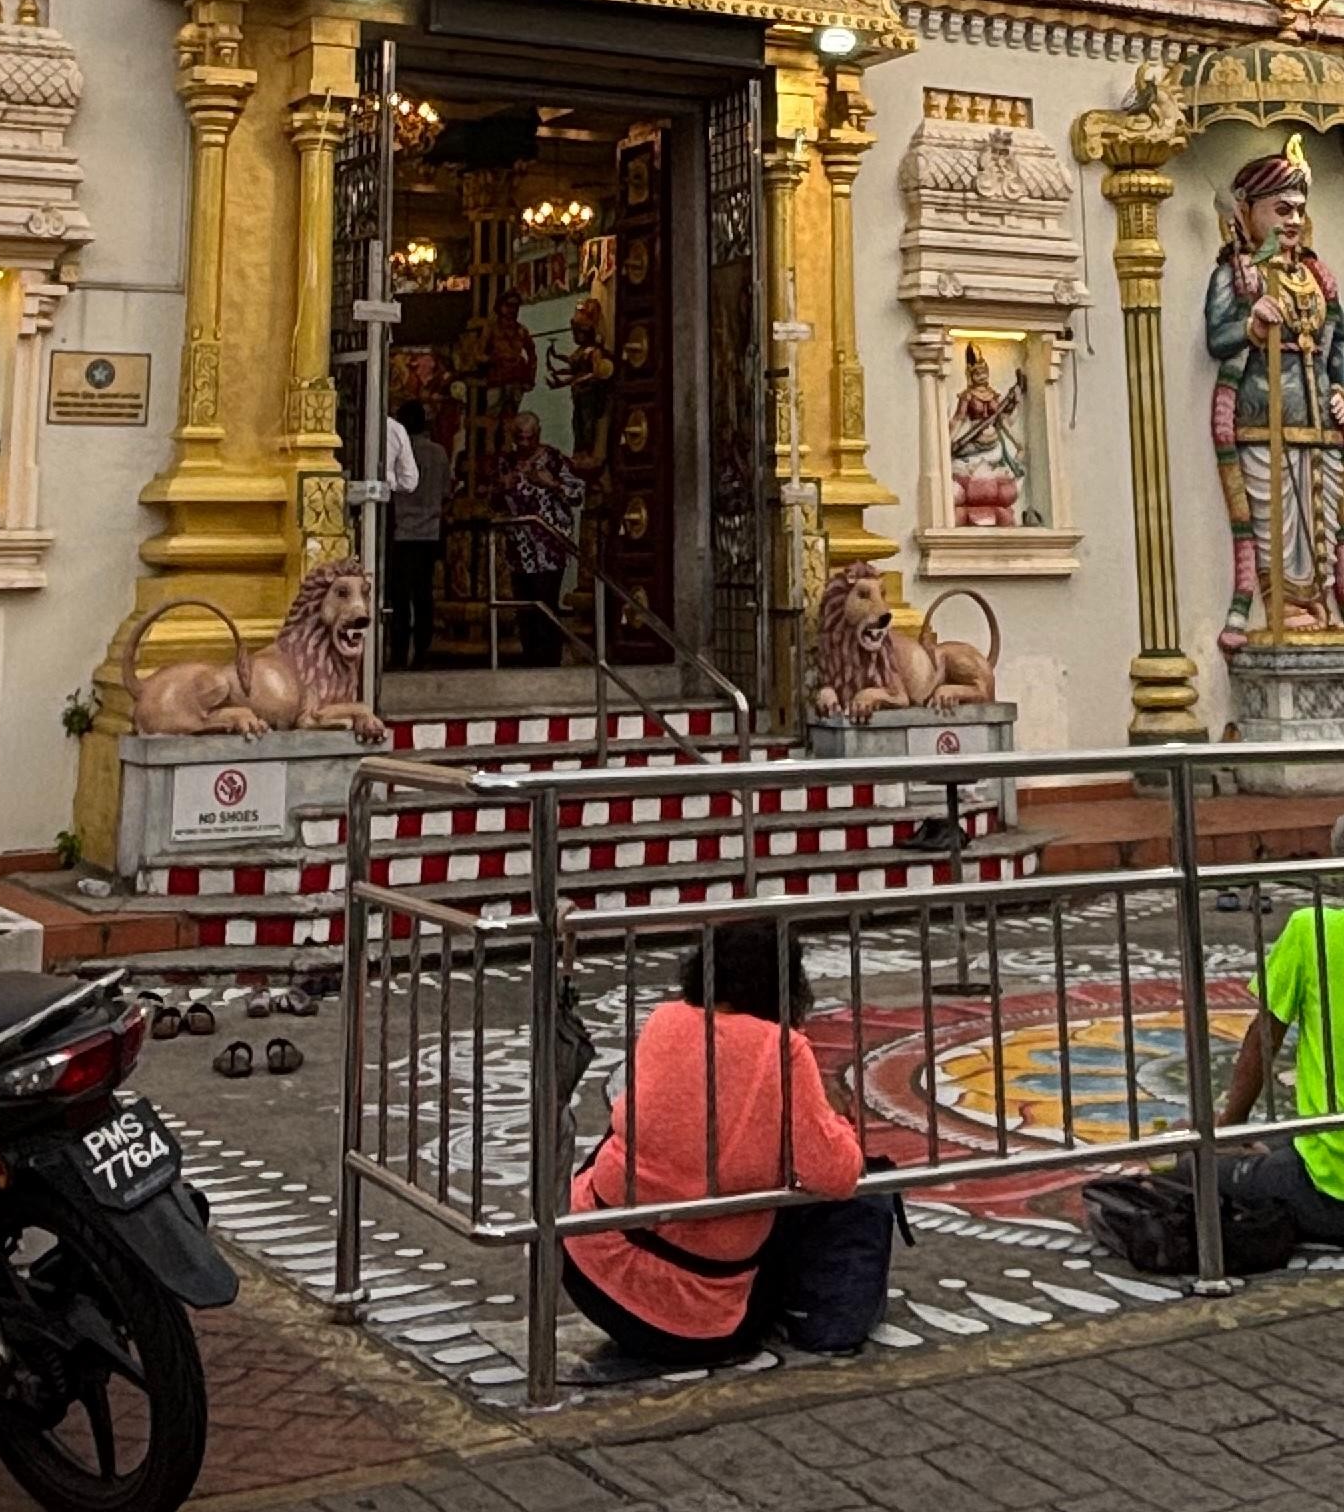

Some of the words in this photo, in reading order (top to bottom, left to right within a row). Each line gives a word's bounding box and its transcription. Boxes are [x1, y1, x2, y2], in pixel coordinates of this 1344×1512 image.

[198, 813, 217, 825] NO
[219, 810, 260, 824] SHOES
[82, 1112, 144, 1162] PMS
[92, 1130, 170, 1190] 7764
